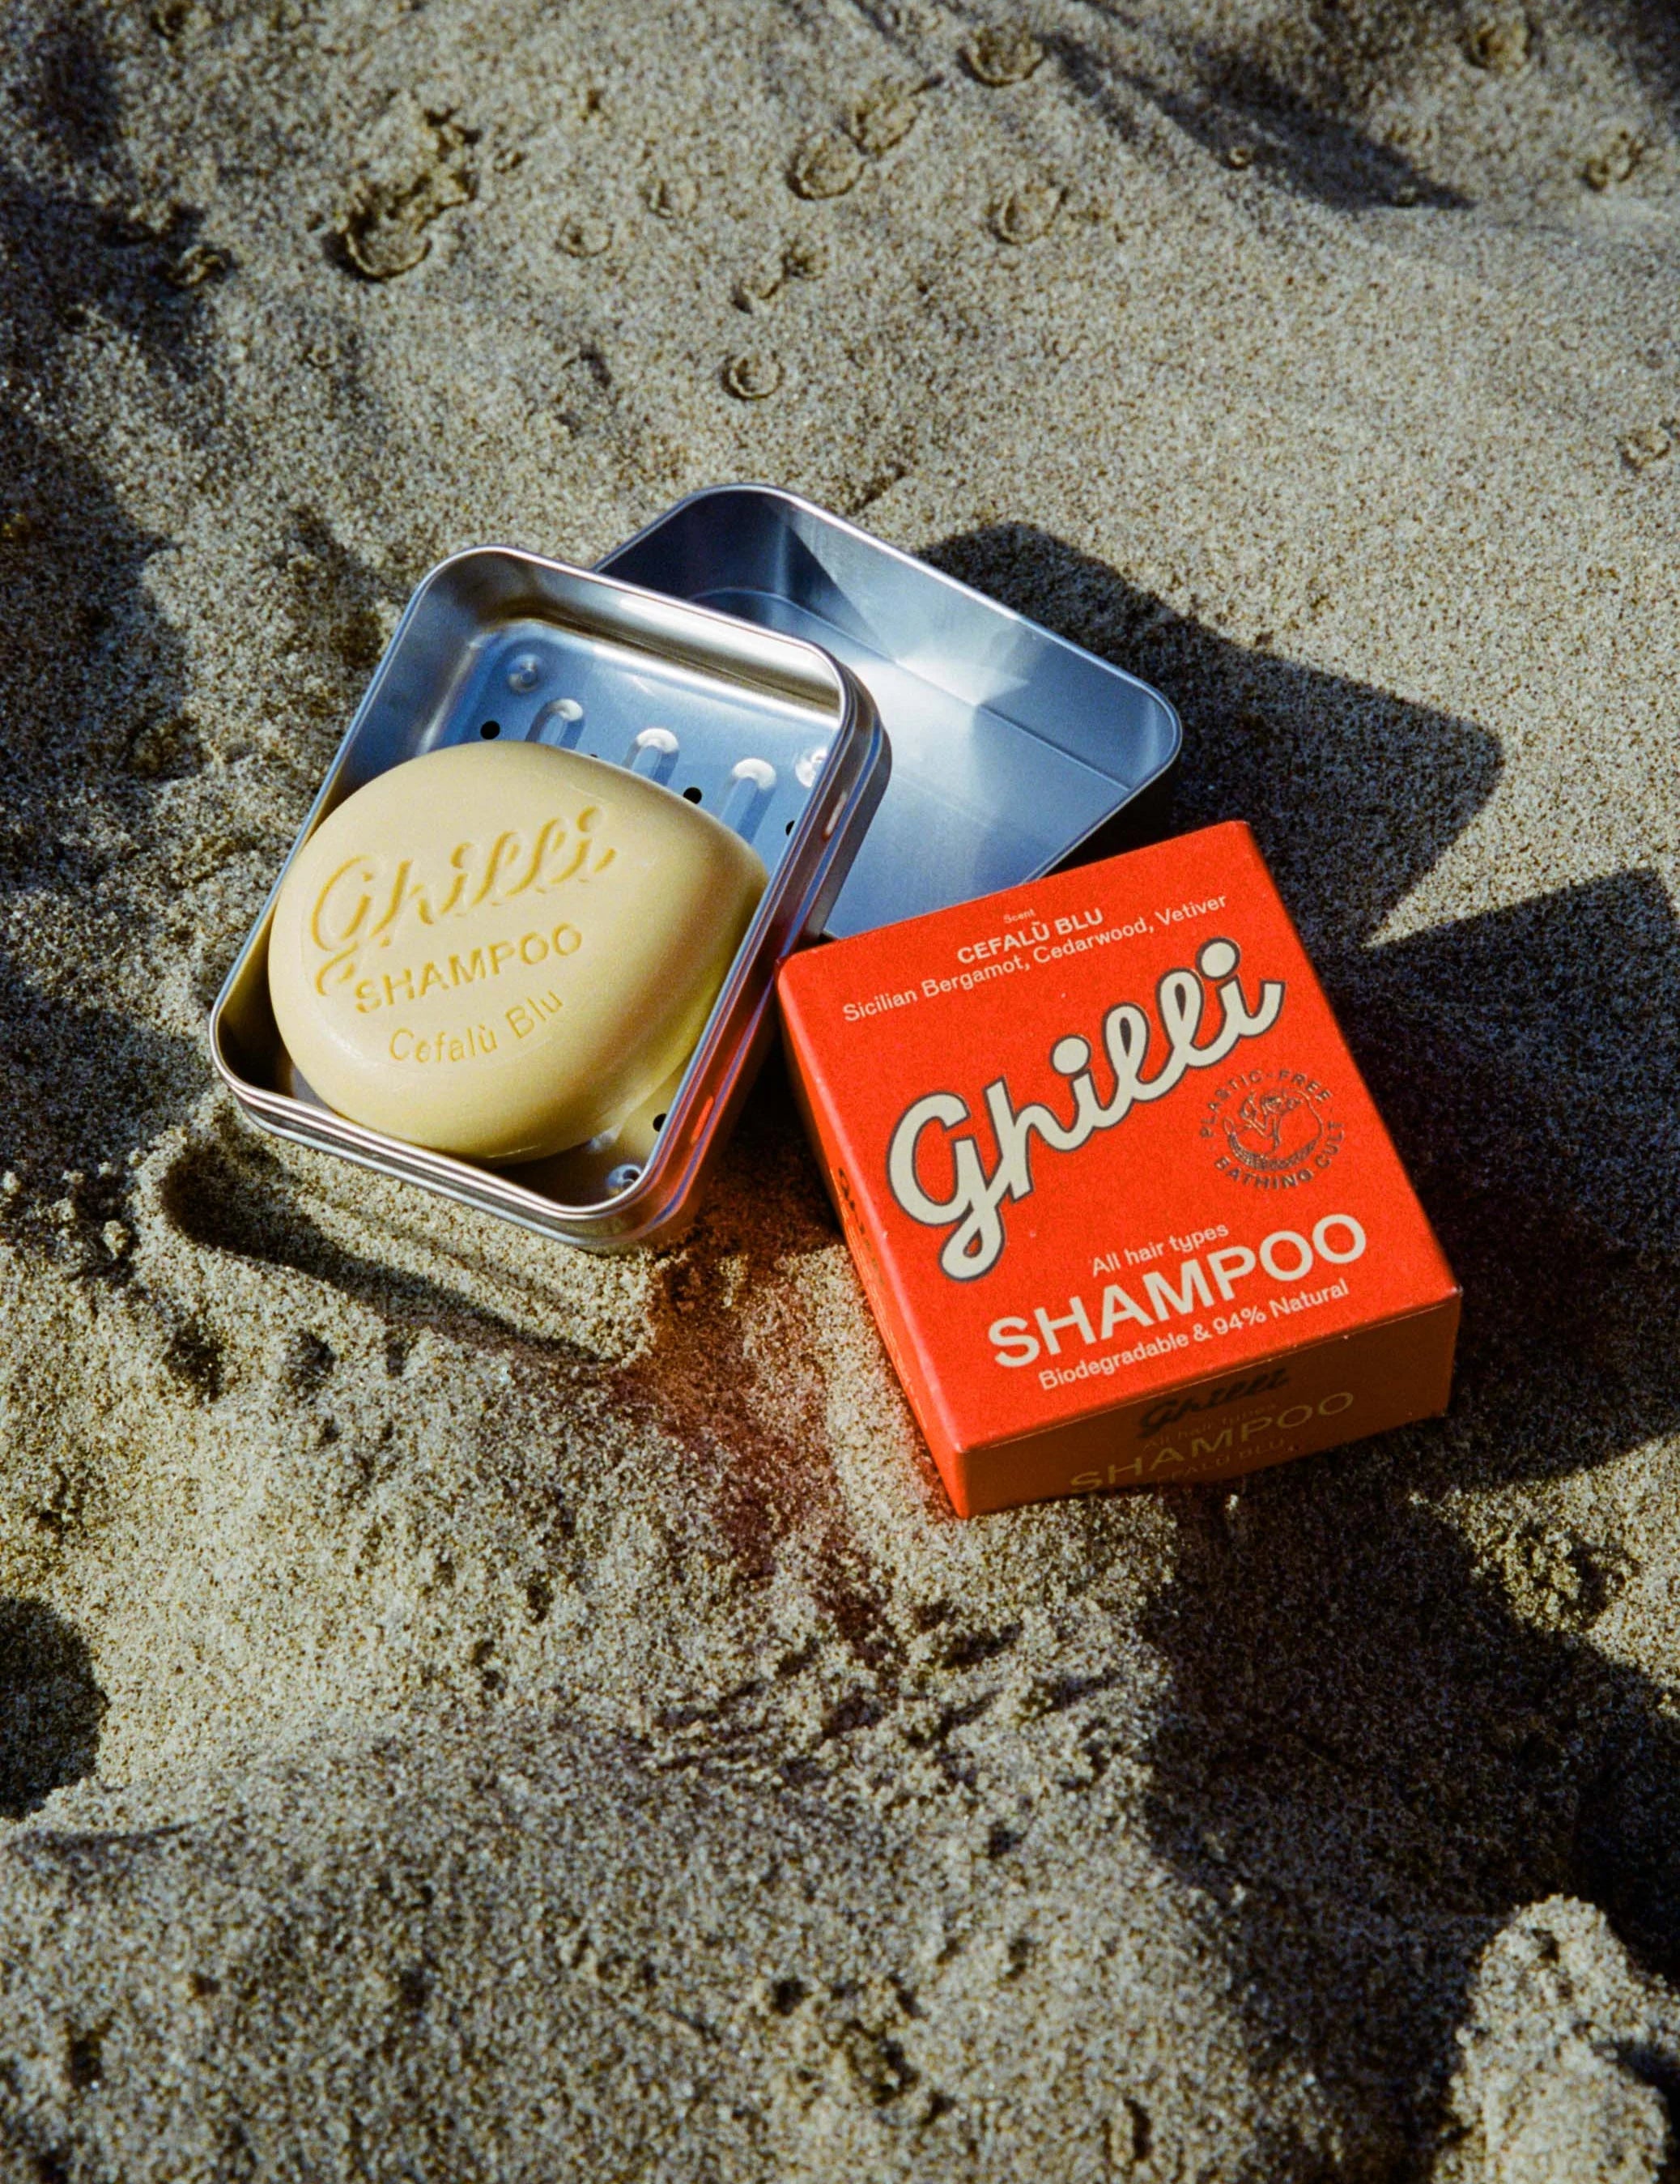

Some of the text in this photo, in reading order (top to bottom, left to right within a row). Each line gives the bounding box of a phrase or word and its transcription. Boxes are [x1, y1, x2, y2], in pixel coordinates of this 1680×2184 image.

[309, 806, 617, 996] Ghilli
[1004, 909, 1036, 924] Scent
[1055, 908, 1104, 935] BLU
[354, 922, 583, 1014] SHAMPOO
[842, 894, 1227, 1022] Sicilian Bergamot, Cedarwood, Vetiver
[389, 990, 564, 1064] Cefalù Blu
[886, 936, 1287, 1284] Ghilli
[1214, 1156, 1315, 1190] BATHING
[988, 1214, 1367, 1369] SHAMPOO
[1091, 1224, 1230, 1278] All hair types
[1038, 1278, 1350, 1390] Biodegradable & 94% Natural
[1070, 1392, 1354, 1493] SHAMPOO
